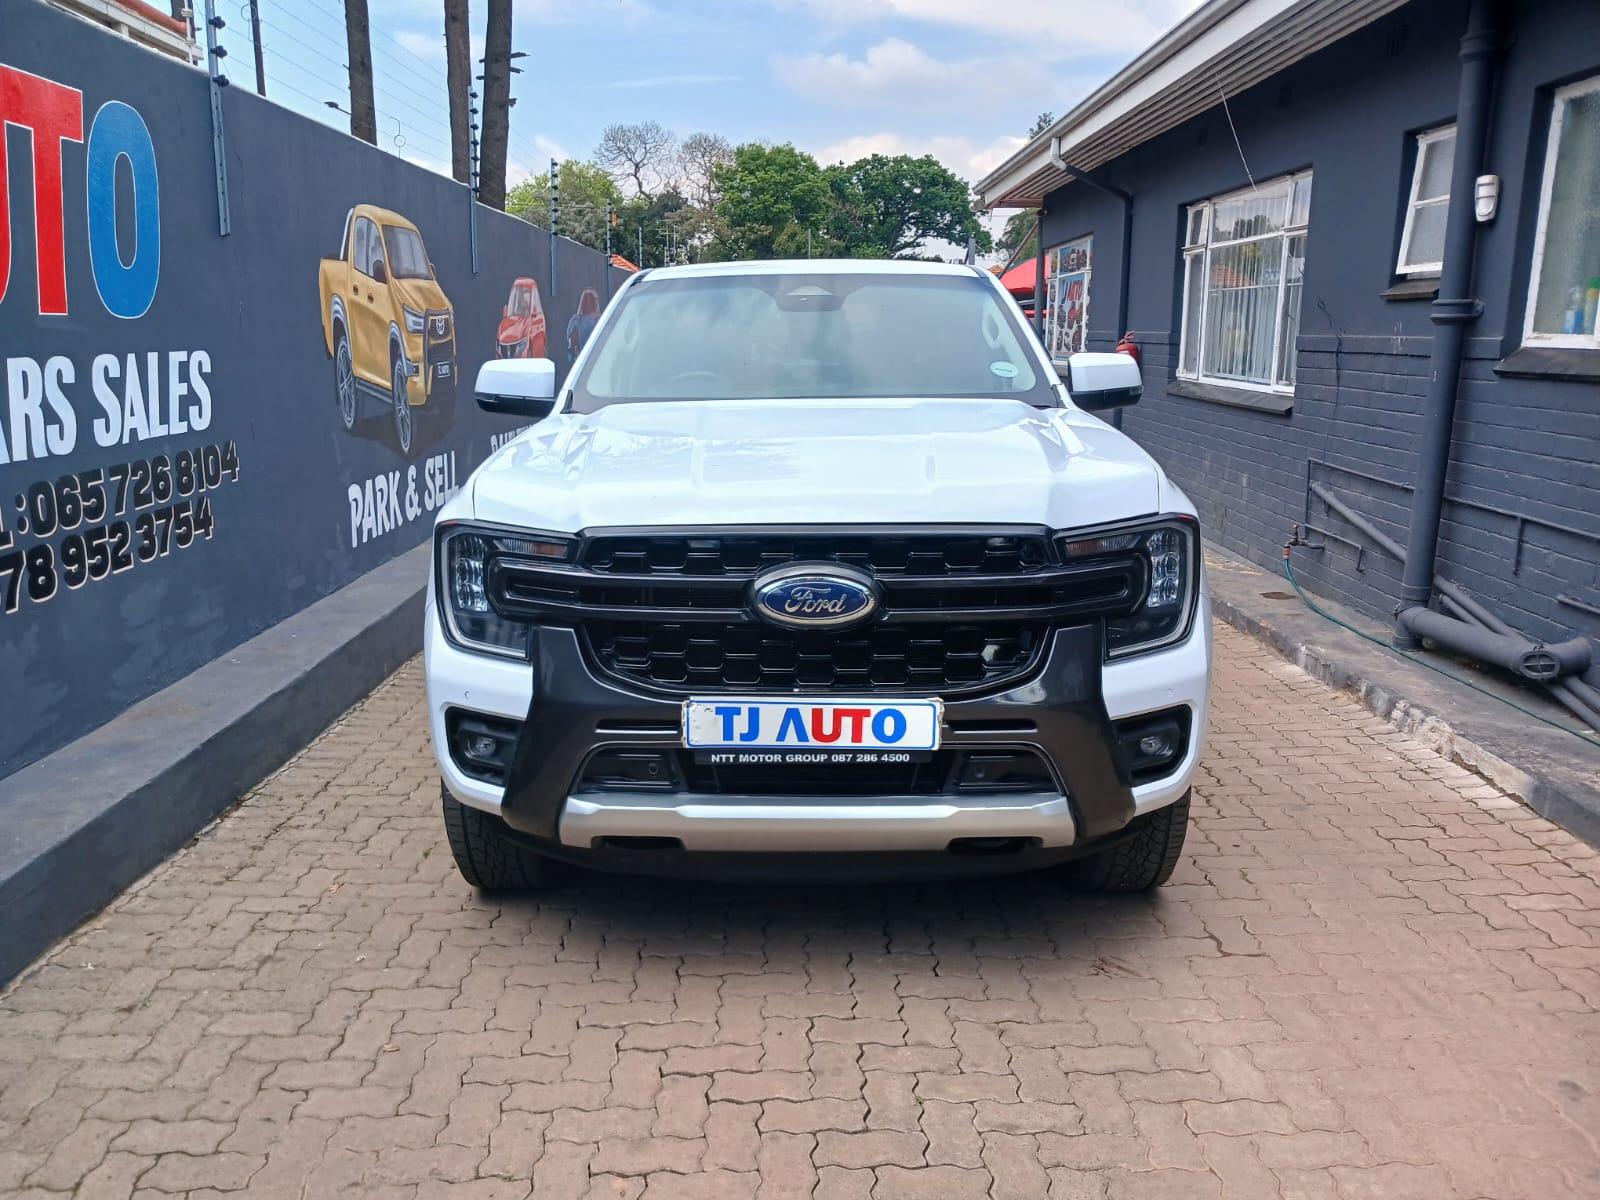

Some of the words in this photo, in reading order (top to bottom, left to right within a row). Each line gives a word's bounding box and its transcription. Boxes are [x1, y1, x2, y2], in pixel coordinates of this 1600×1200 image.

[91, 349, 212, 447] SALES
[109, 455, 174, 516] 726
[175, 440, 240, 497] 8104
[347, 470, 404, 548] PARK
[405, 464, 422, 522] &
[424, 450, 460, 511] SELL
[60, 520, 134, 589] 952
[135, 496, 214, 563] 3754
[784, 586, 847, 613] Ford
[710, 753, 736, 764] NTT
[738, 753, 783, 764] MOTOR
[785, 753, 829, 764] GROUP
[831, 753, 853, 763] 087
[855, 753, 878, 763] 286
[880, 752, 911, 763] 4500
[715, 706, 760, 742] TJ
[776, 707, 907, 744] AUTO
